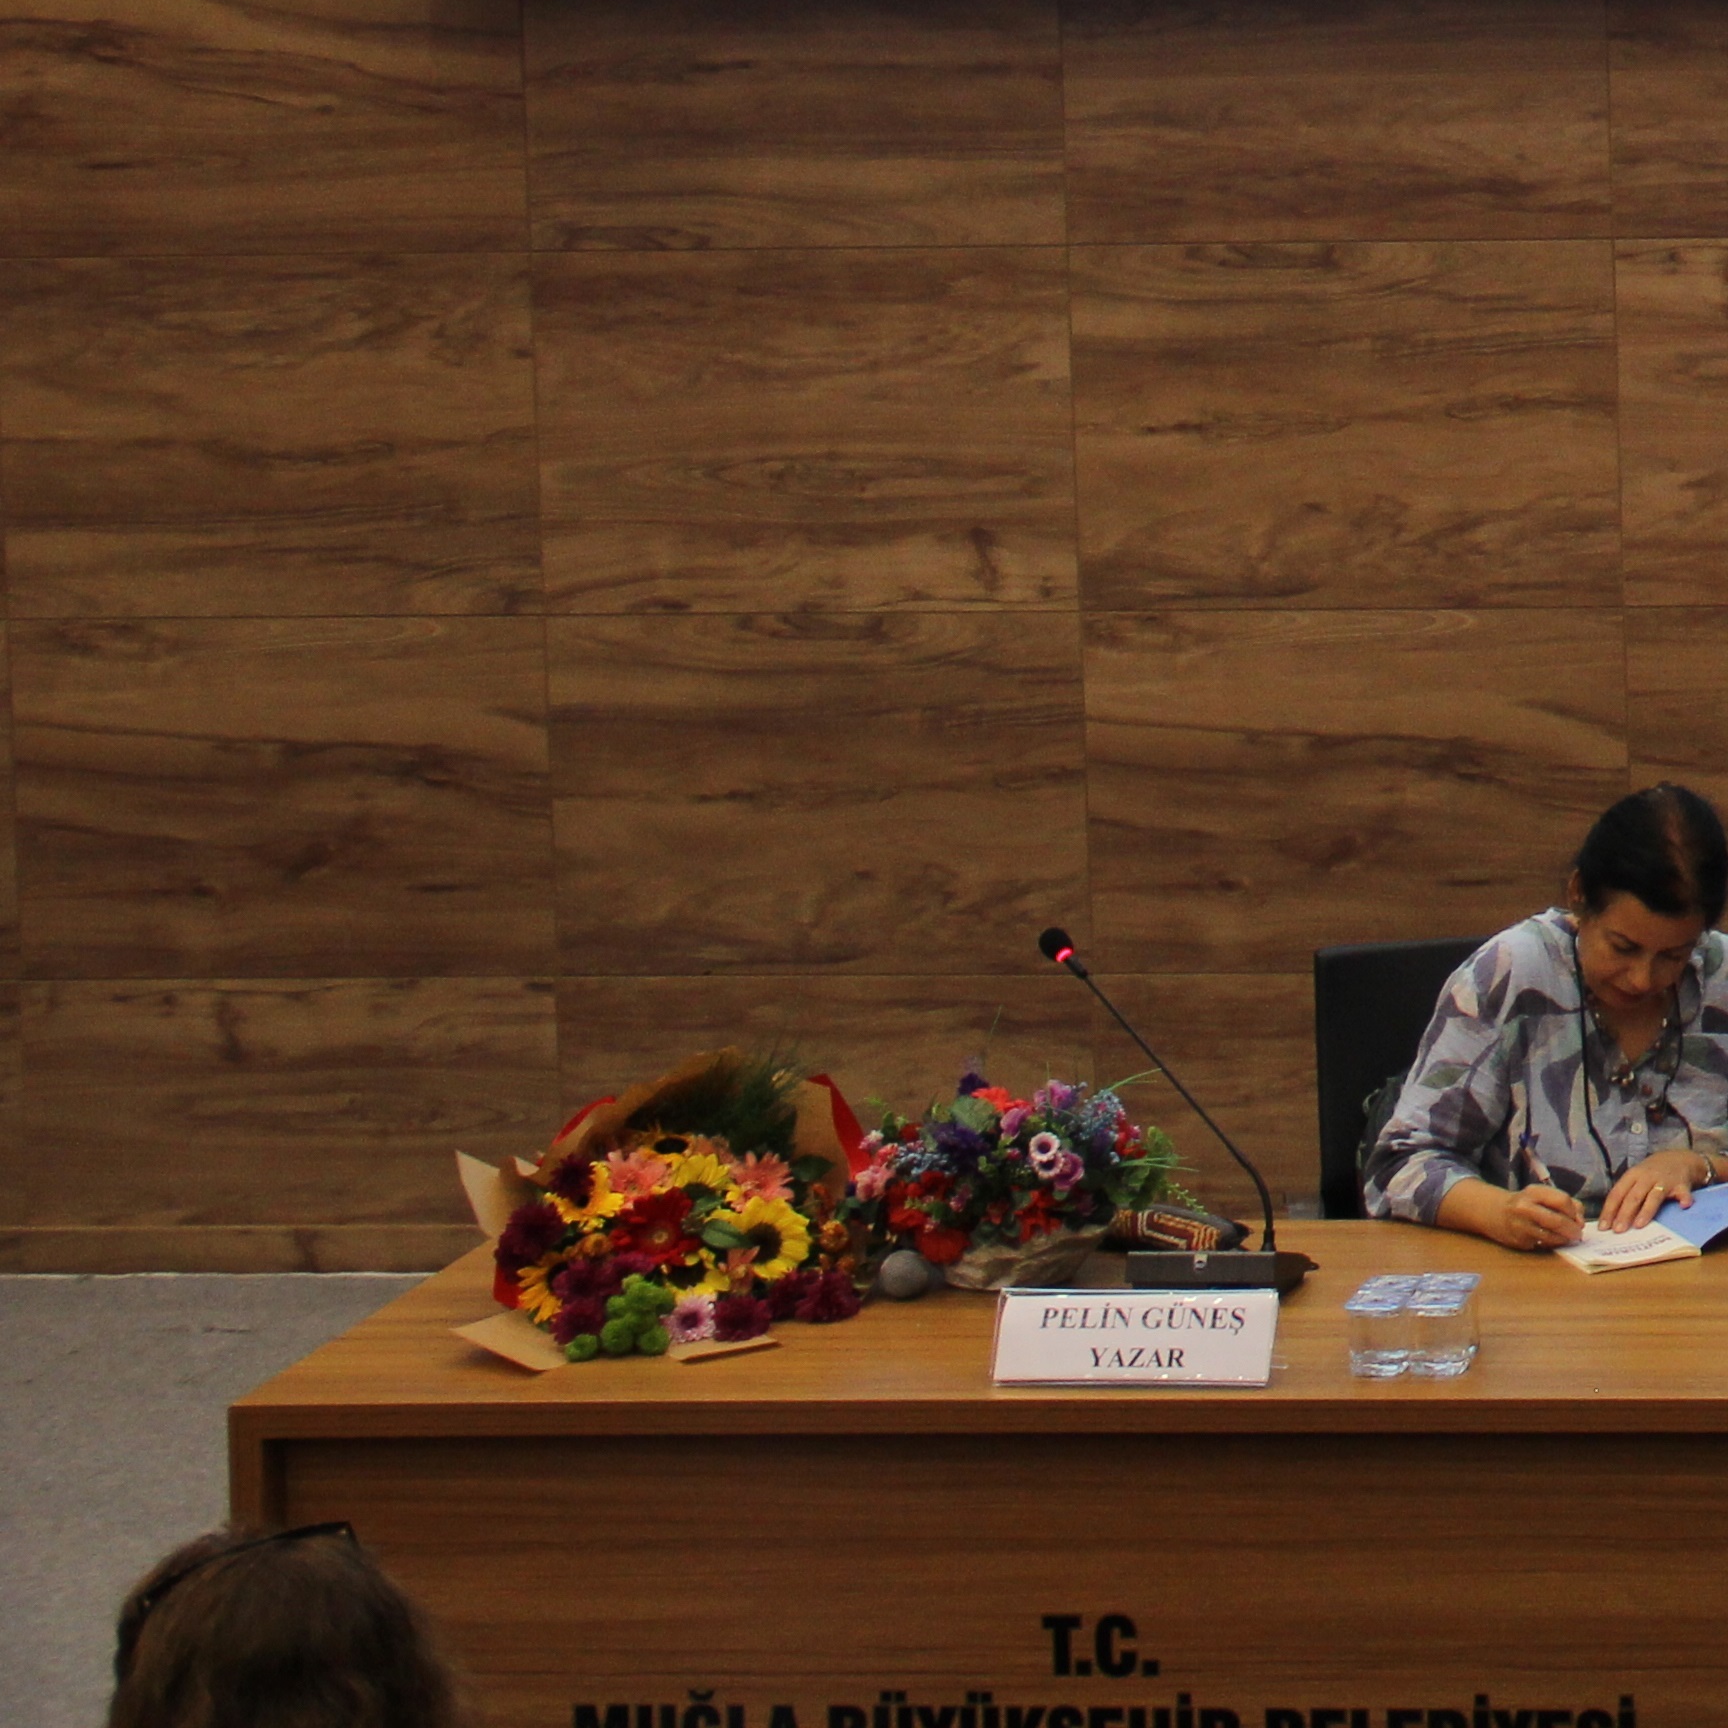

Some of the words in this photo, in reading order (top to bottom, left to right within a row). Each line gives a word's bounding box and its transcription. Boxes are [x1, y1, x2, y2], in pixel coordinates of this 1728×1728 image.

[1039, 1302, 1134, 1330] PELİN
[1141, 1301, 1247, 1336] GÜNEŞ
[1090, 1346, 1186, 1369] YAZAR
[1041, 1613, 1161, 1677] T.C.
